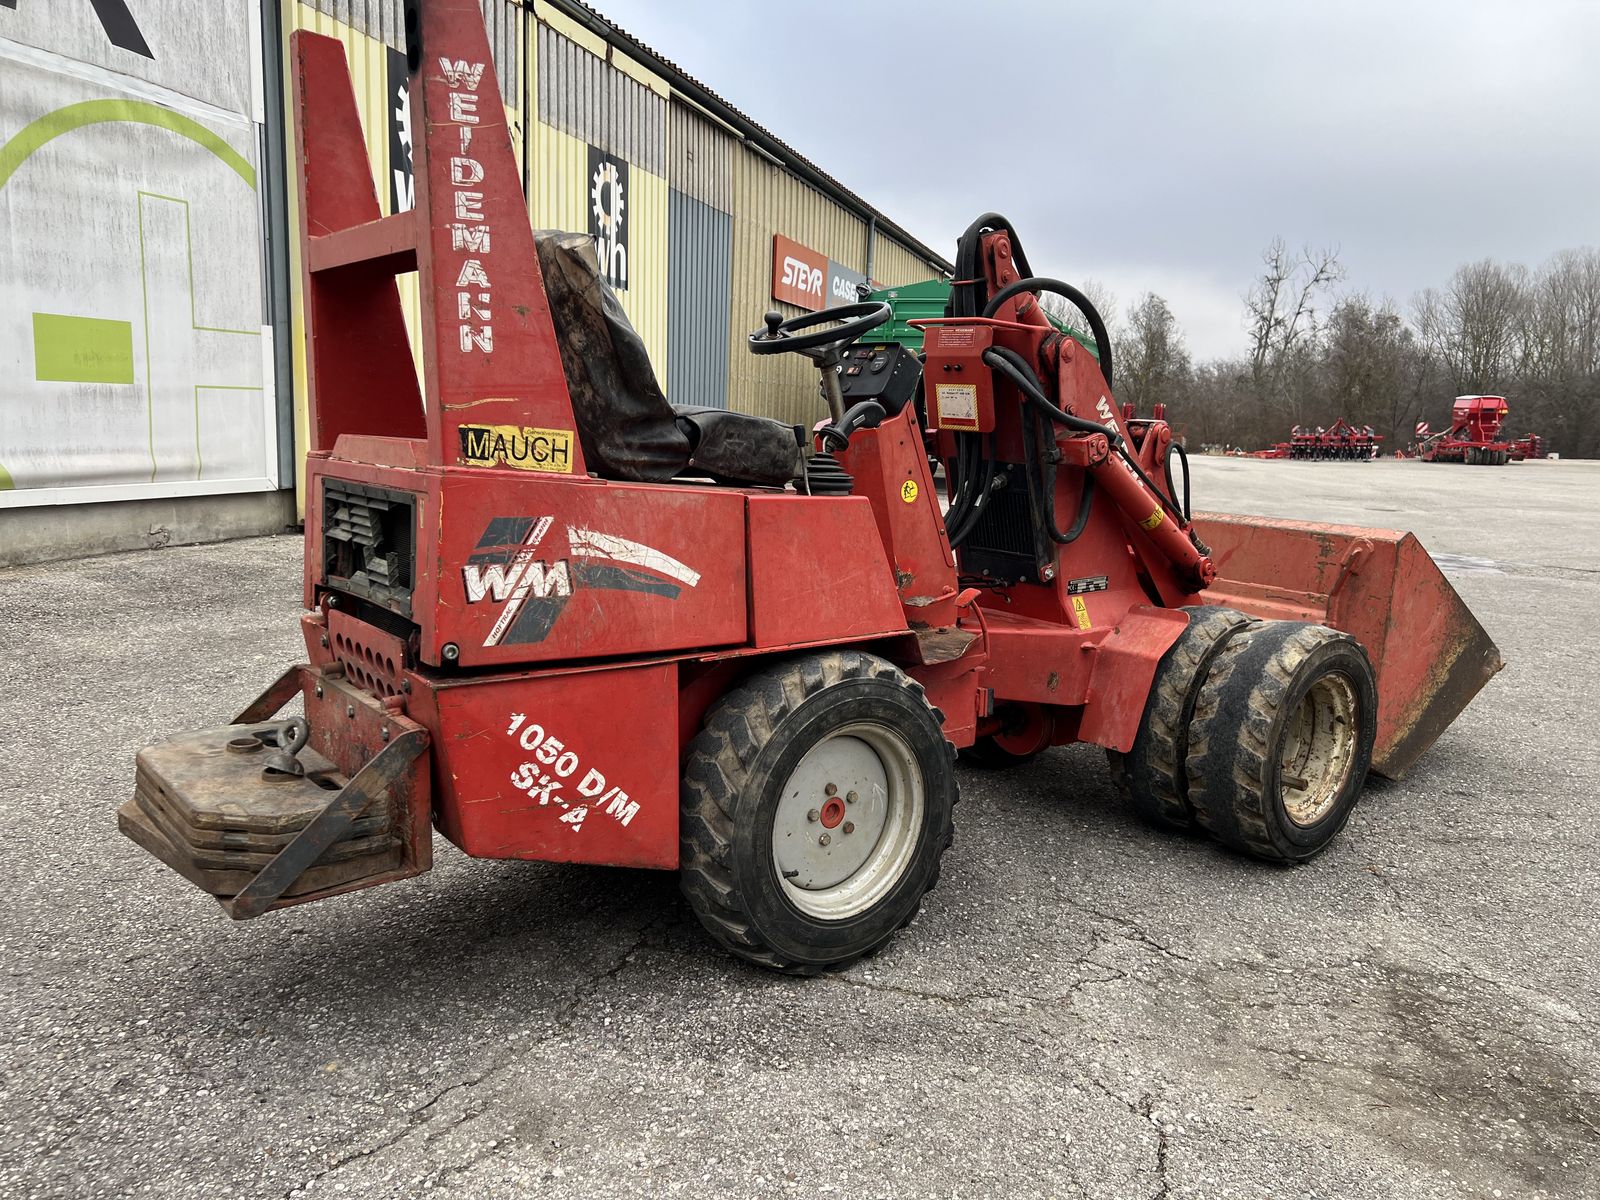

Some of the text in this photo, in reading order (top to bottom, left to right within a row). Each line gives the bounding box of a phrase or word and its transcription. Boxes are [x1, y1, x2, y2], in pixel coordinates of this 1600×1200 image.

[439, 57, 493, 353] WEIDEMANN
[781, 256, 822, 296] STEYR
[466, 430, 569, 464] MAUCH
[506, 712, 641, 828] 1050 D/M
[510, 760, 589, 833] SK-A
